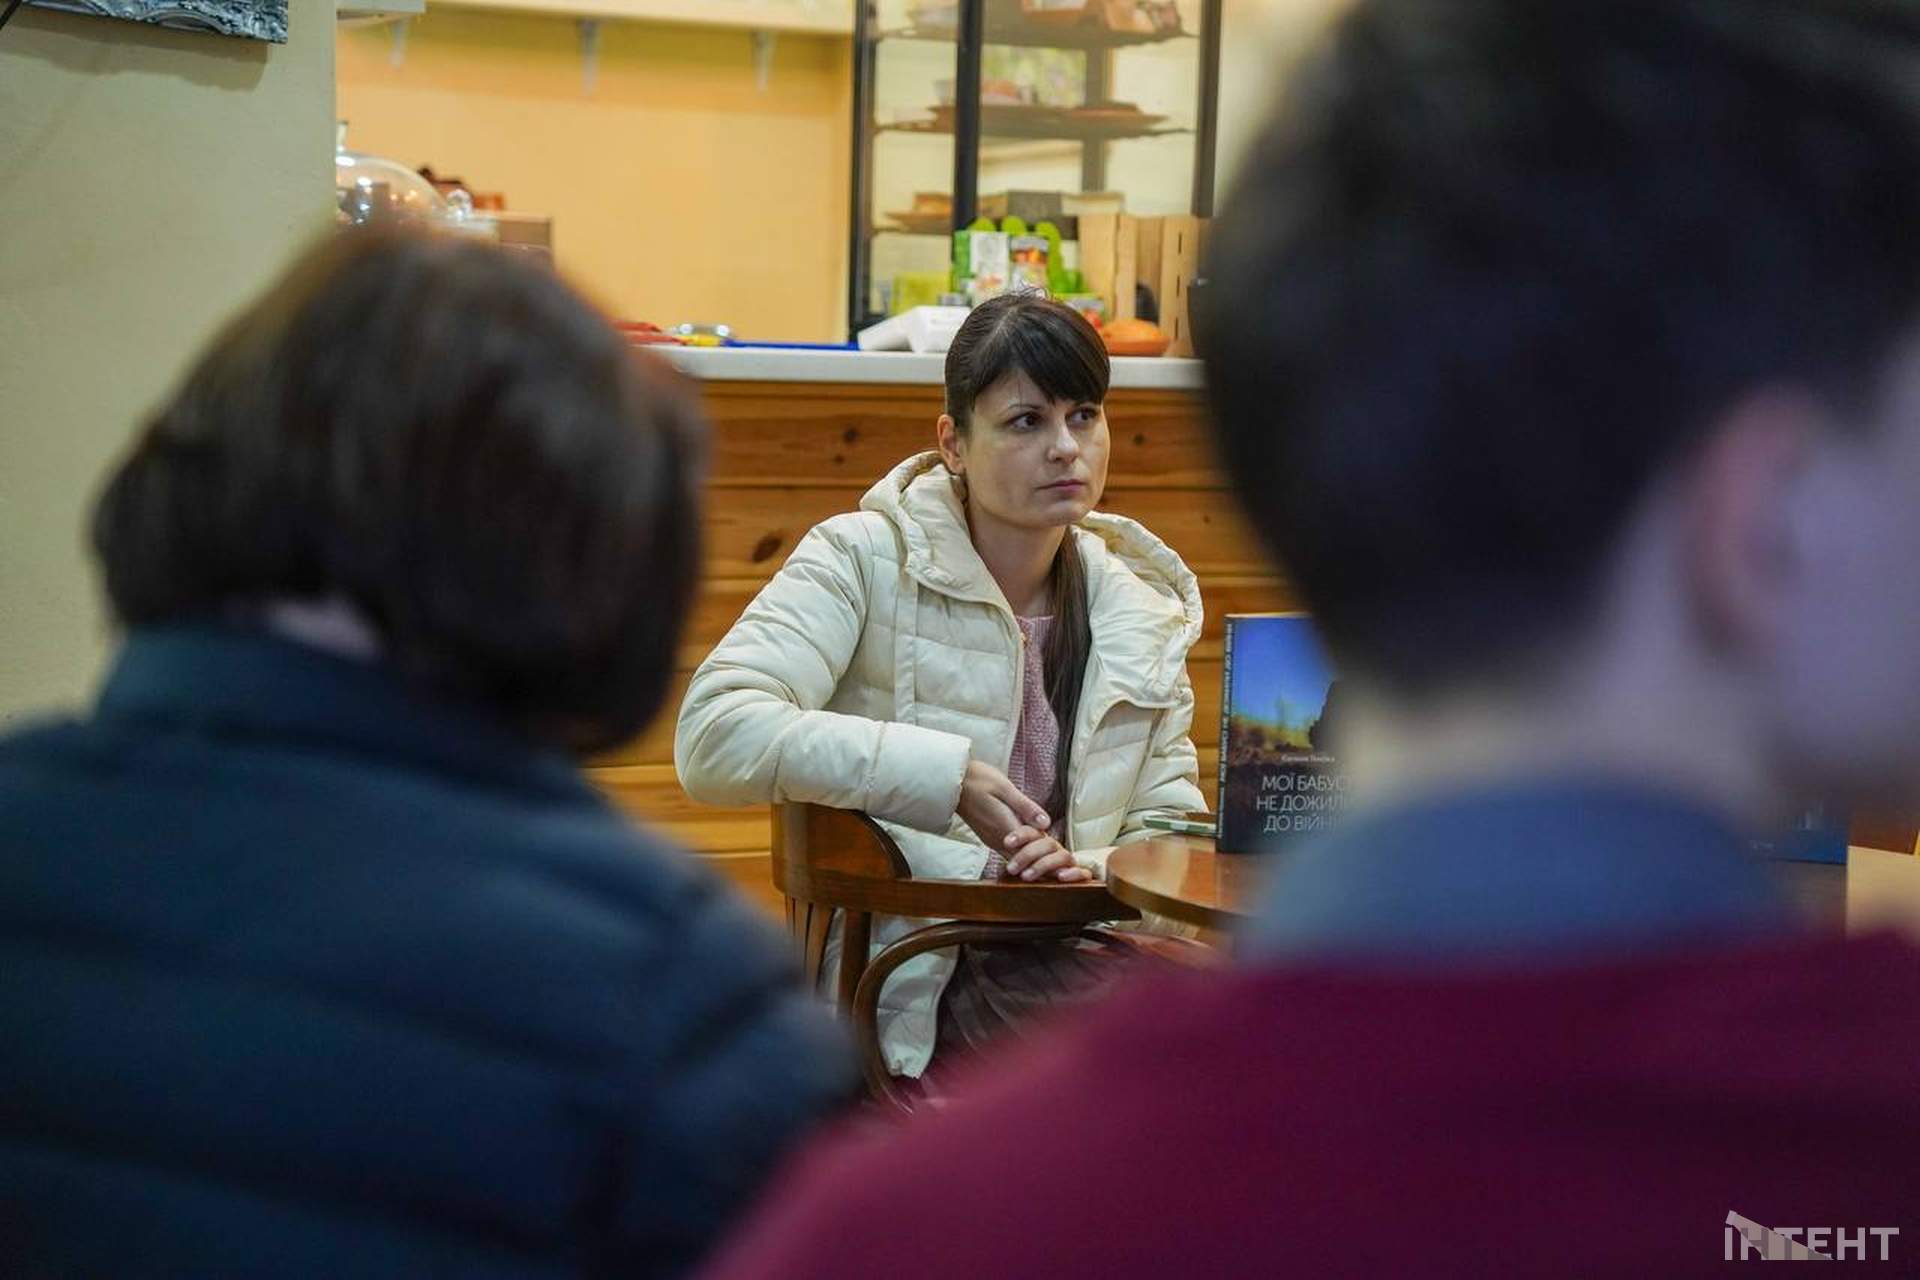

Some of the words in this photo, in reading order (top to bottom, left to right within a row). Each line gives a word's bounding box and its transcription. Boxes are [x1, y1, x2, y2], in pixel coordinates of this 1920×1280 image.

[1262, 772, 1294, 791] МОЇ
[1297, 775, 1345, 791] БАБУС
[1256, 794, 1278, 811] НЕ
[1280, 794, 1345, 813] ДОЖИЛ
[1263, 815, 1290, 833] ДО
[1294, 813, 1338, 831] ВІЙН
